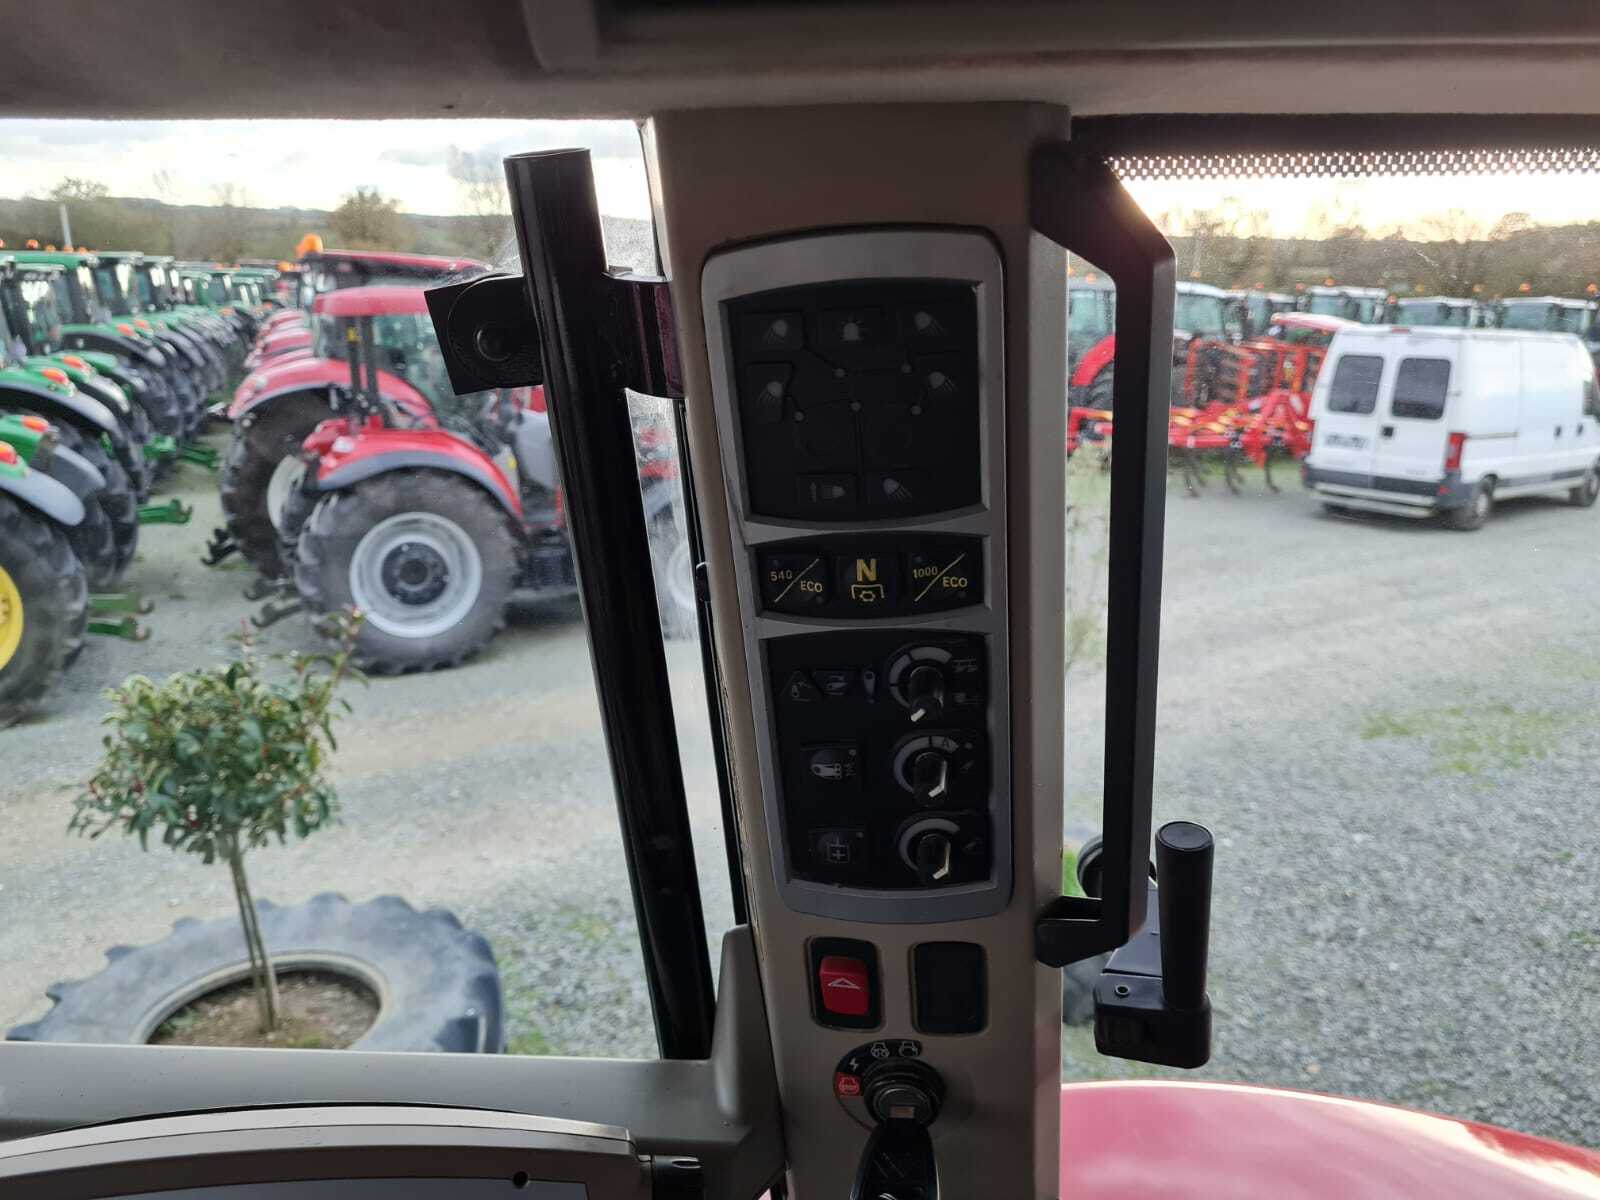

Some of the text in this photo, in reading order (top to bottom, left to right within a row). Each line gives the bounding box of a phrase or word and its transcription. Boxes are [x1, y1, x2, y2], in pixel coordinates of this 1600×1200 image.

[769, 570, 793, 582] 540
[856, 558, 877, 582] N
[912, 566, 939, 579] 1000
[800, 581, 823, 593] ECO
[942, 576, 968, 588] ECO
